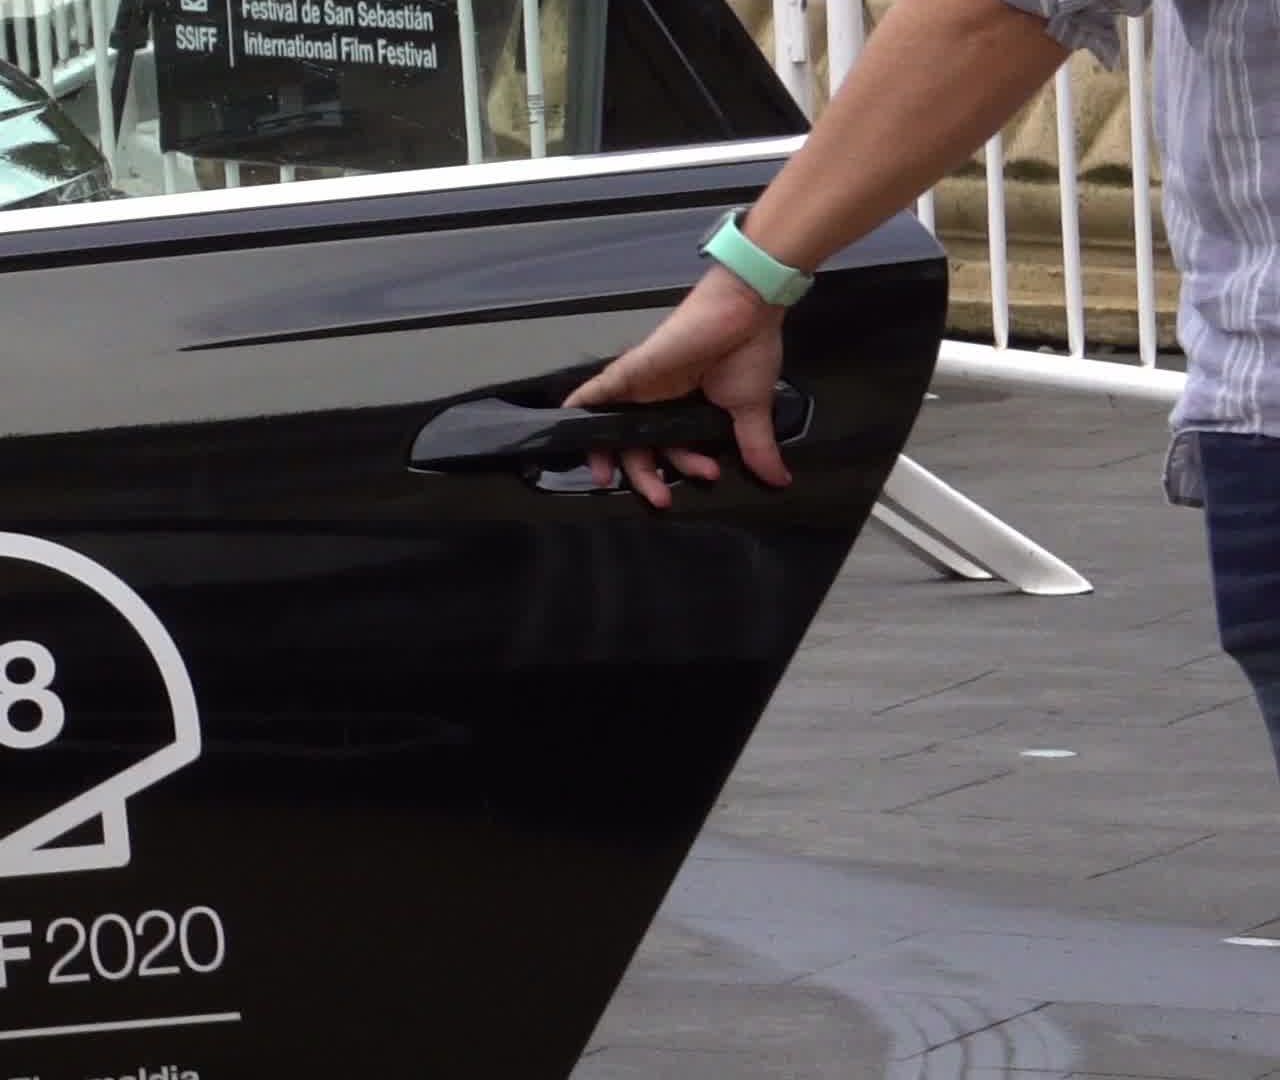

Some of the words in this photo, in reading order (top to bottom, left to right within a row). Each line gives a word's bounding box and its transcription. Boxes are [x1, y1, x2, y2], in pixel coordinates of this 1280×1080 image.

[324, 0, 354, 26] San
[357, 1, 434, 31] Sebastián
[175, 24, 218, 53] SSIFF
[243, 30, 338, 60] International
[341, 36, 374, 63] Film
[377, 38, 438, 69] Festival
[45, 905, 226, 985] 2020
